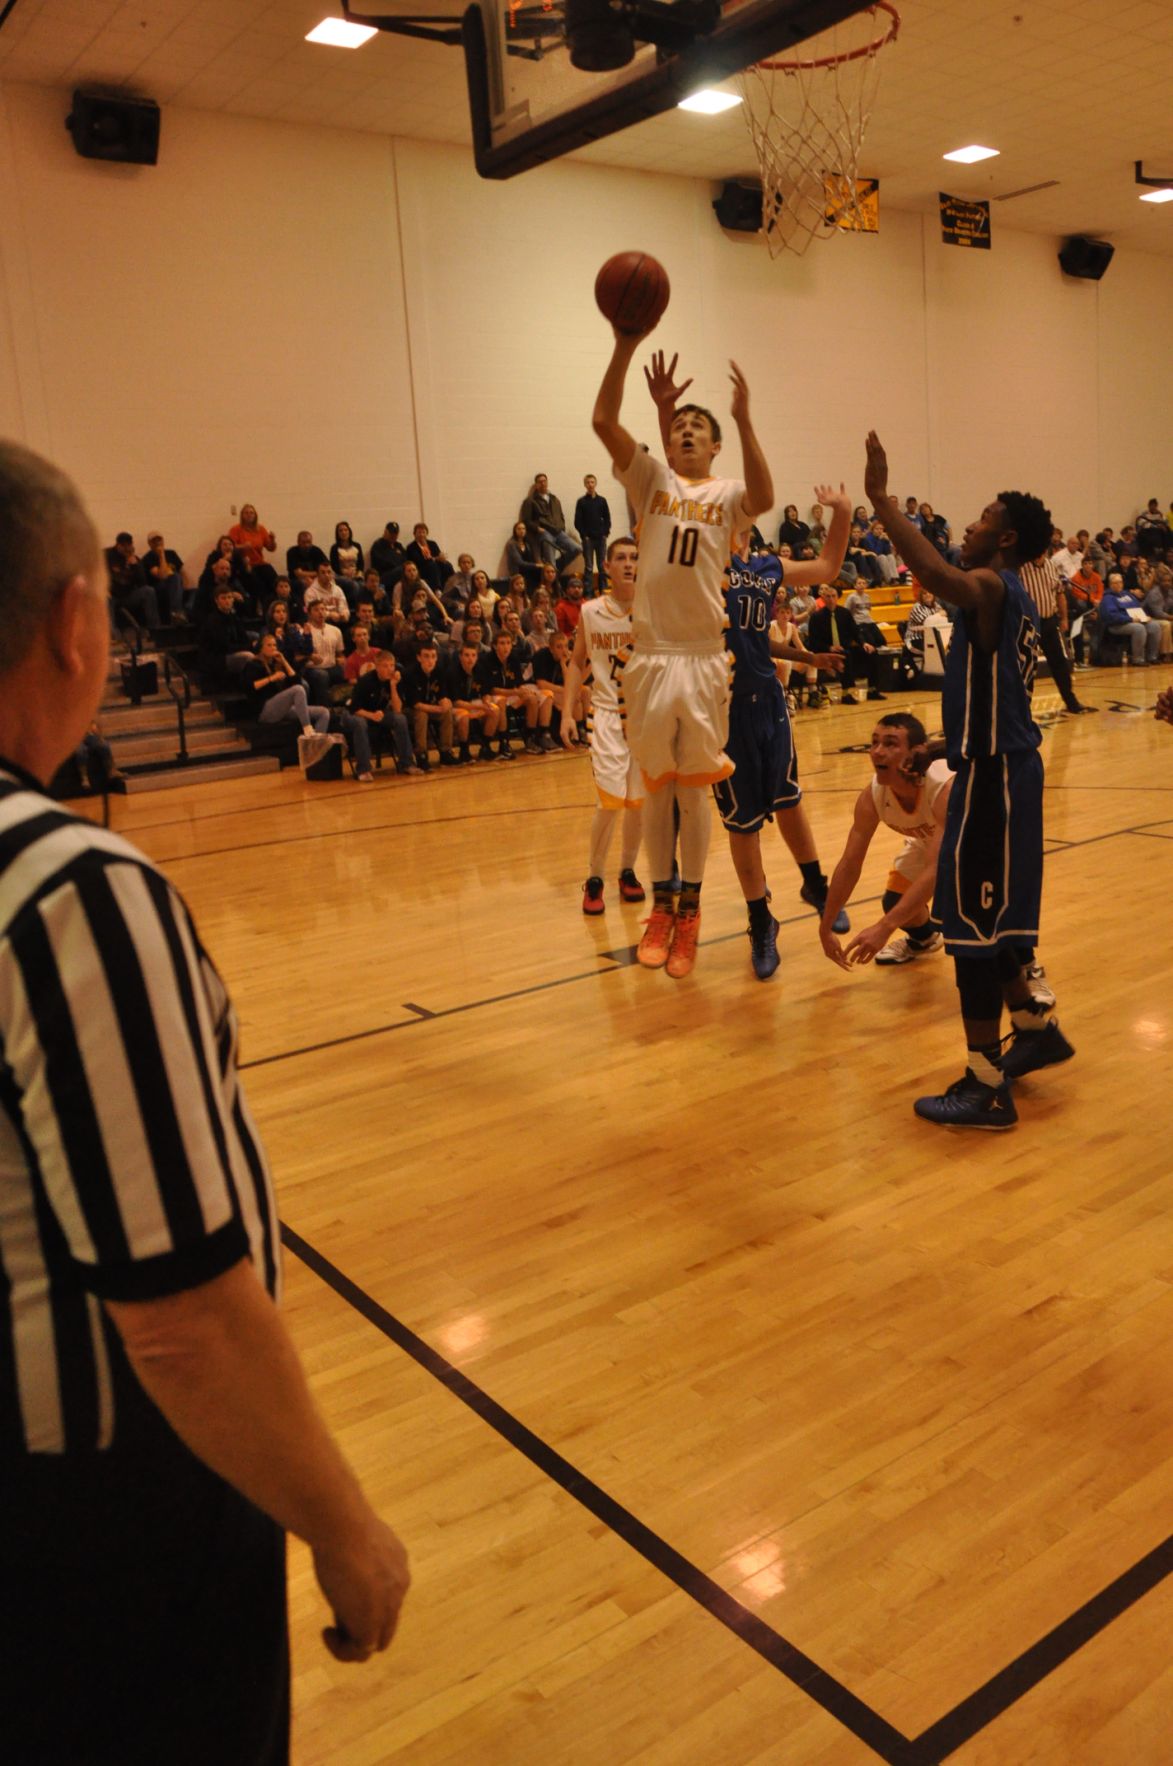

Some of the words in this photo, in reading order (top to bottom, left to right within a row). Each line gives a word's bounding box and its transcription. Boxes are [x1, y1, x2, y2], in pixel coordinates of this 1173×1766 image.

[649, 490, 724, 526] PANTHERS
[667, 525, 699, 567] 10
[737, 594, 767, 632] 10
[981, 880, 993, 910] C
